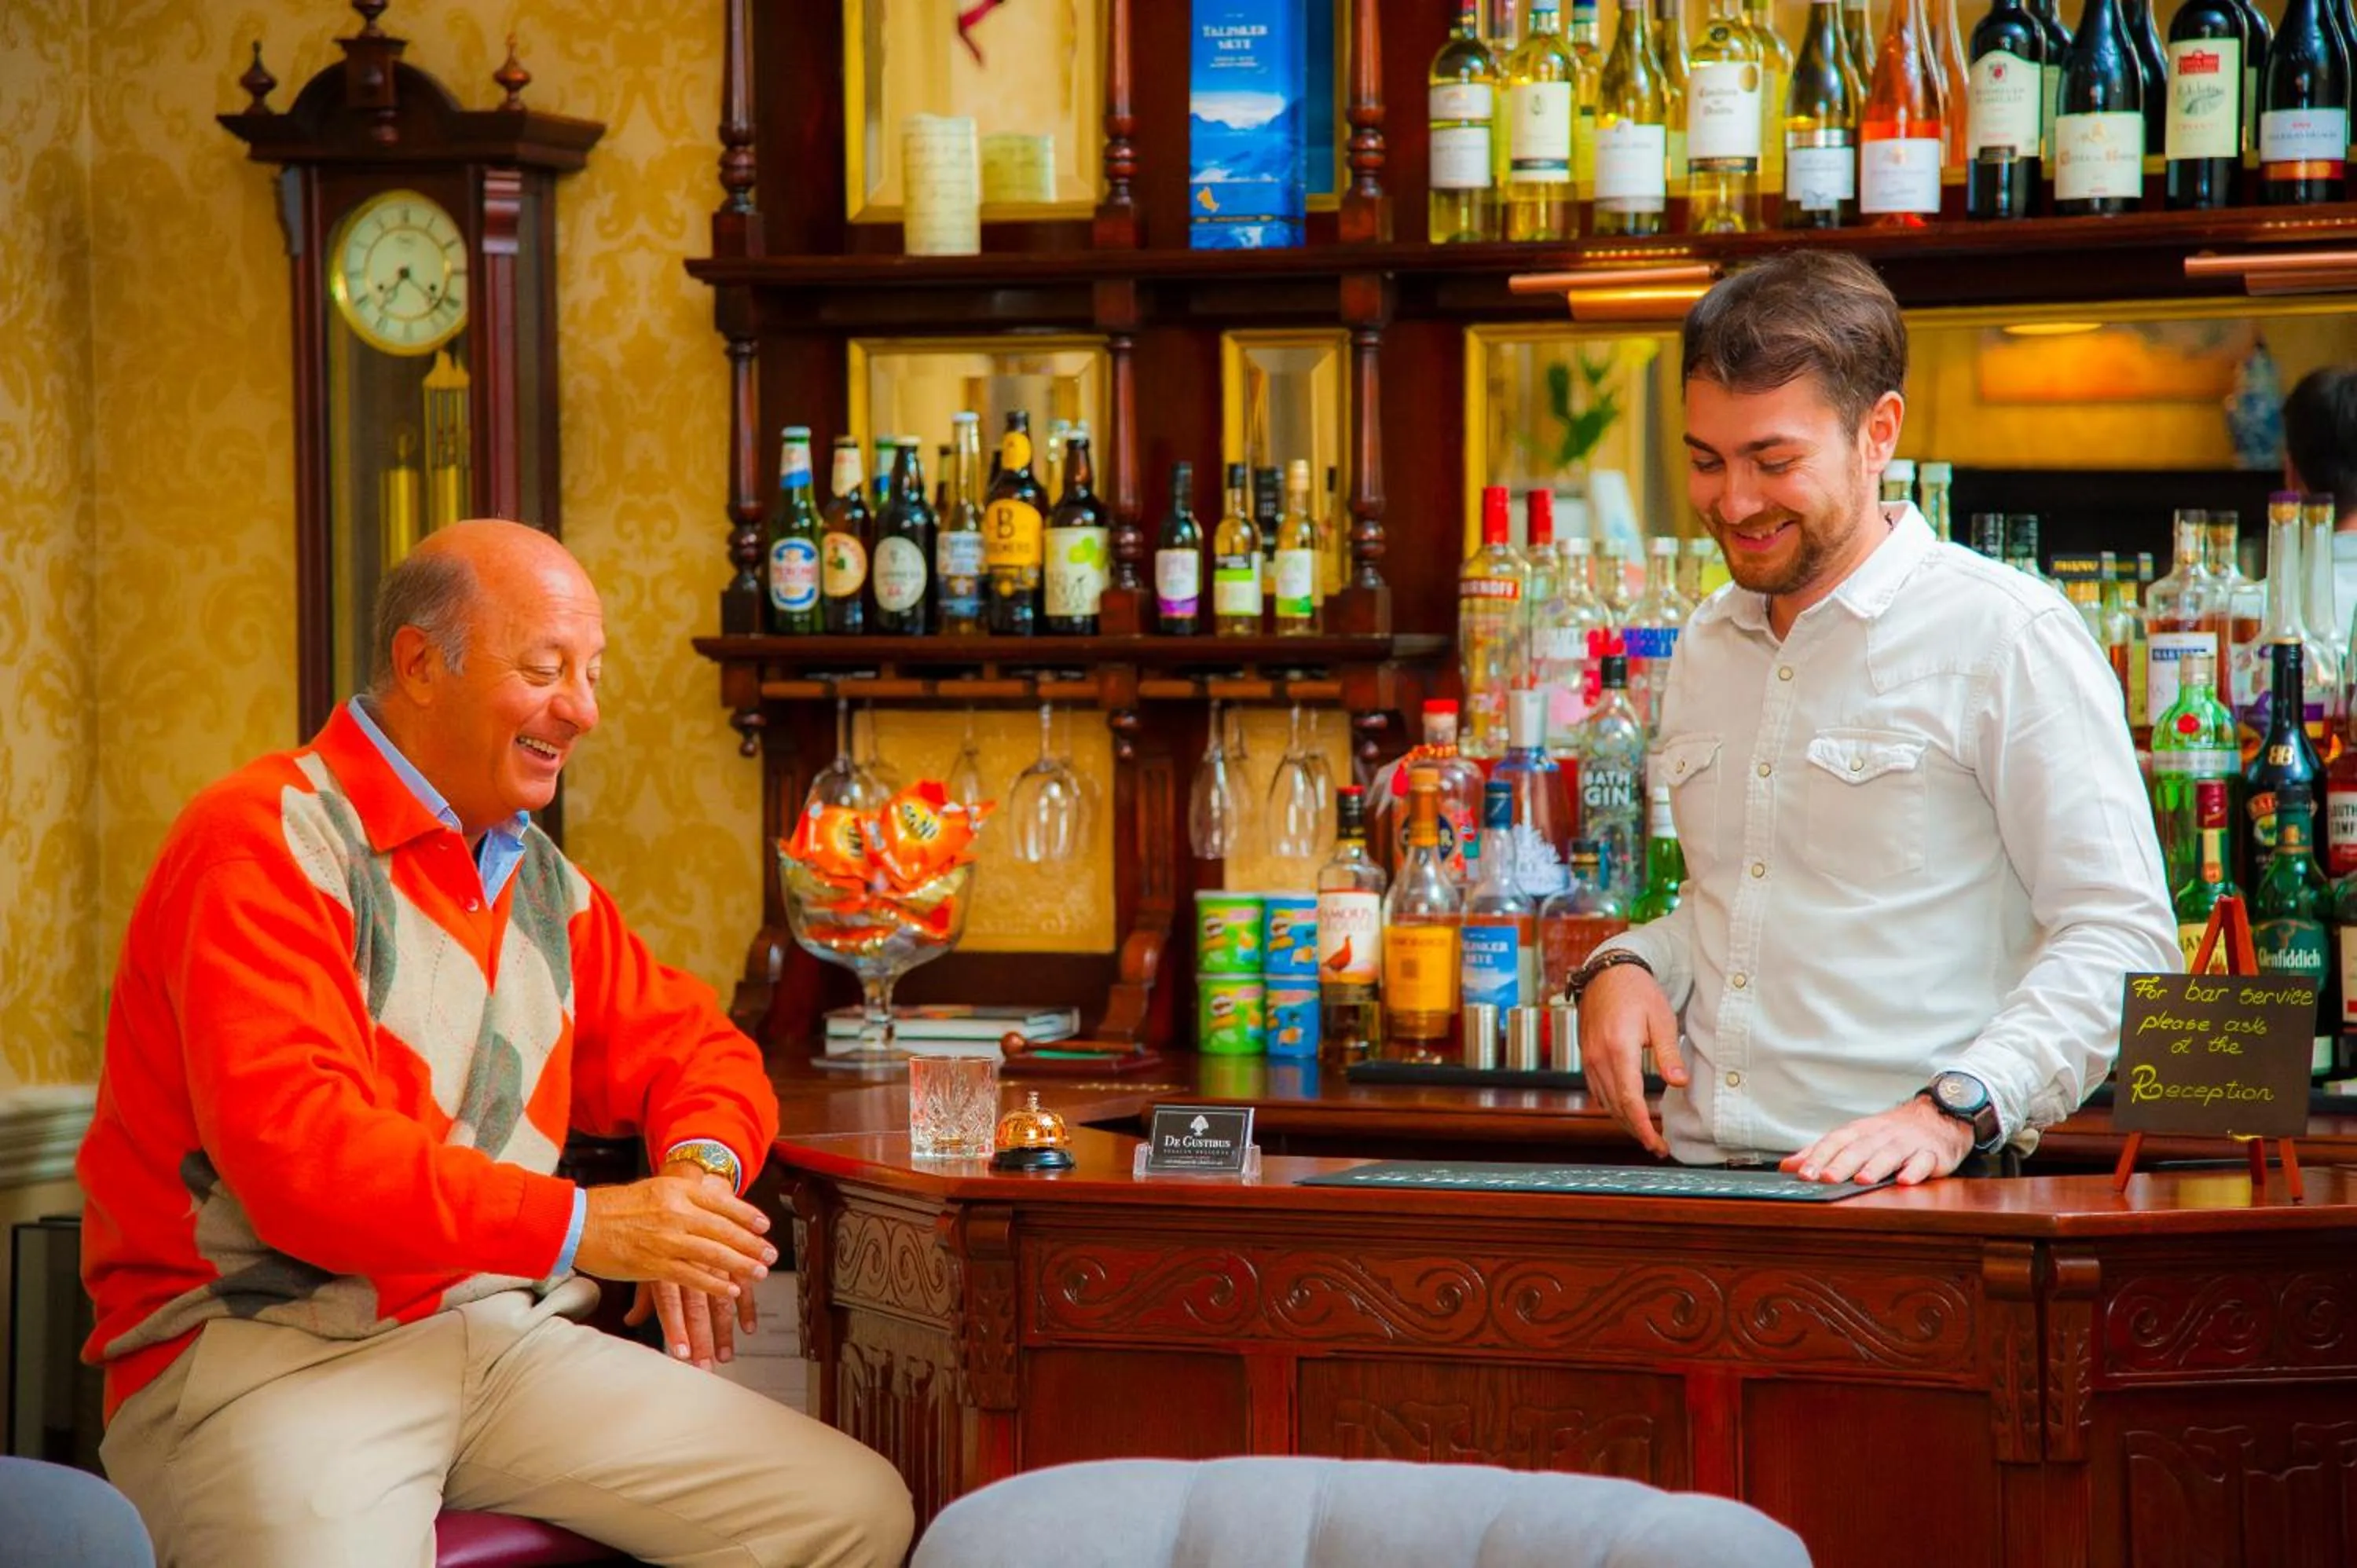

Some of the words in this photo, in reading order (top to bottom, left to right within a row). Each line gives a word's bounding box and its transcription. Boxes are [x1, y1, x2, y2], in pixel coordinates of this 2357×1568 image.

[1584, 770, 1631, 786] BATH
[1584, 786, 1631, 808] GIN
[2132, 976, 2168, 1002] For
[2185, 979, 2229, 1002] bar
[2239, 987, 2314, 1006] service
[2137, 1010, 2210, 1035] please
[2224, 1015, 2267, 1035] ask
[2208, 1035, 2243, 1055] the
